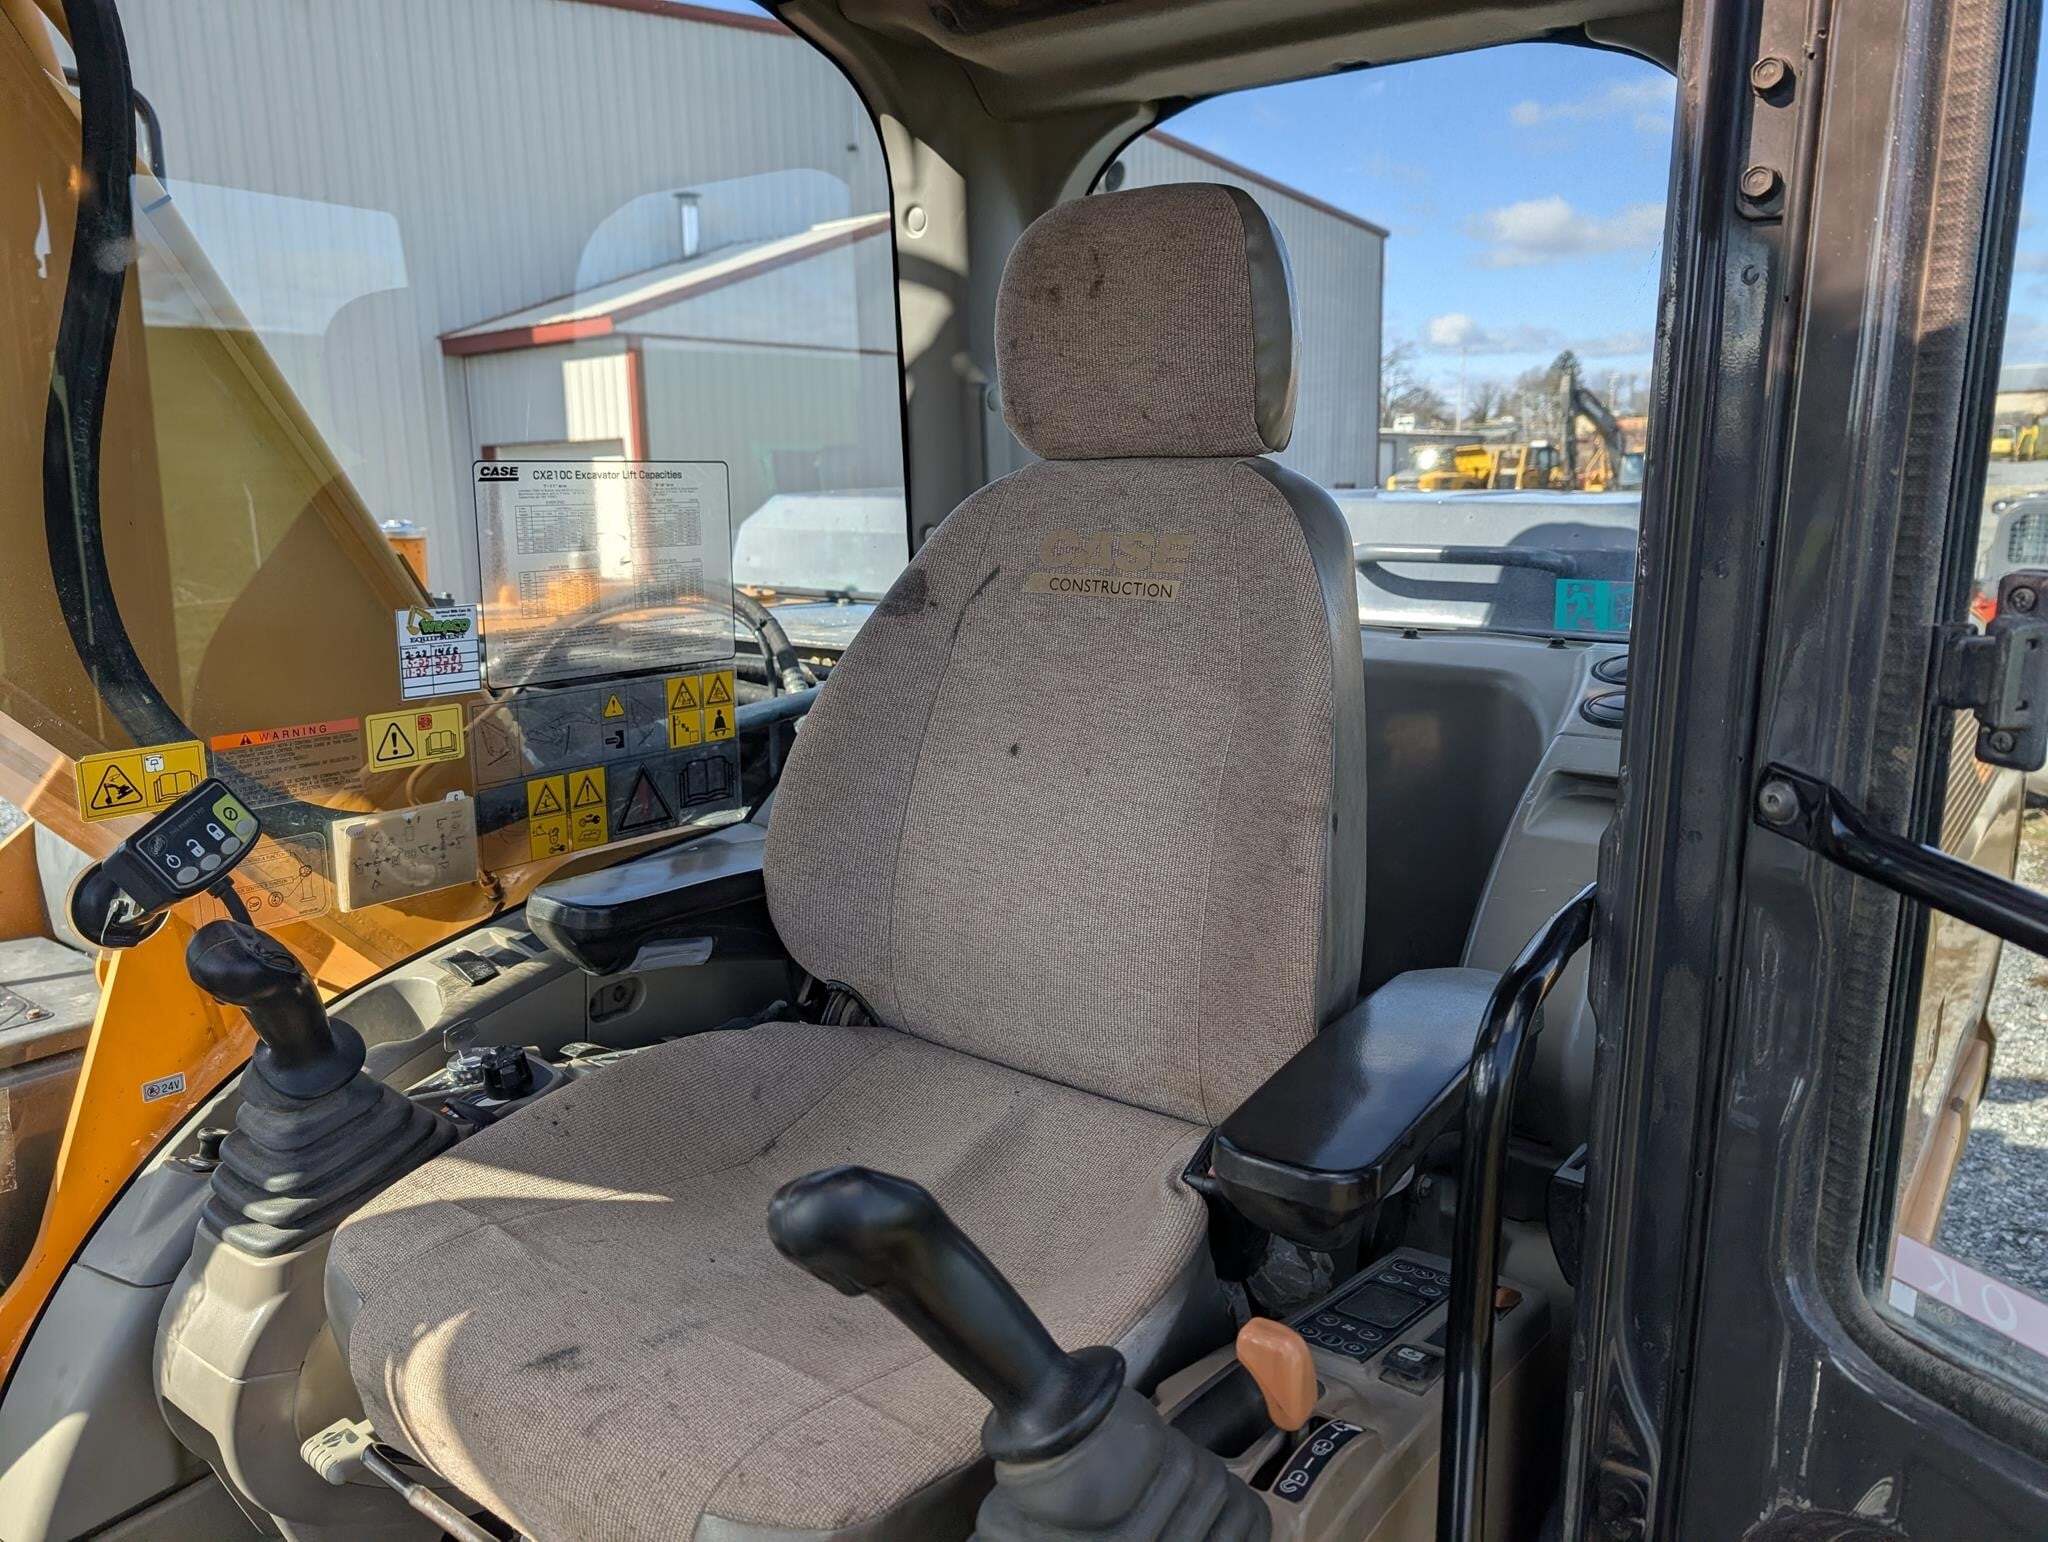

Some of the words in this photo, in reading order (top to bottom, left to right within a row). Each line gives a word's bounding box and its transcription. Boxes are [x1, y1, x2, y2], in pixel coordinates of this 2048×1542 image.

[481, 466, 519, 477] CASE
[533, 470, 573, 480] CX210C
[575, 470, 620, 480] Excavator
[623, 470, 638, 480] Lift
[639, 469, 683, 480] Capacities
[1049, 577, 1173, 599] CONSTRUCTION
[409, 633, 464, 642] EQUIPMENT
[258, 724, 328, 742] WARNING
[161, 1080, 179, 1093] 24V
